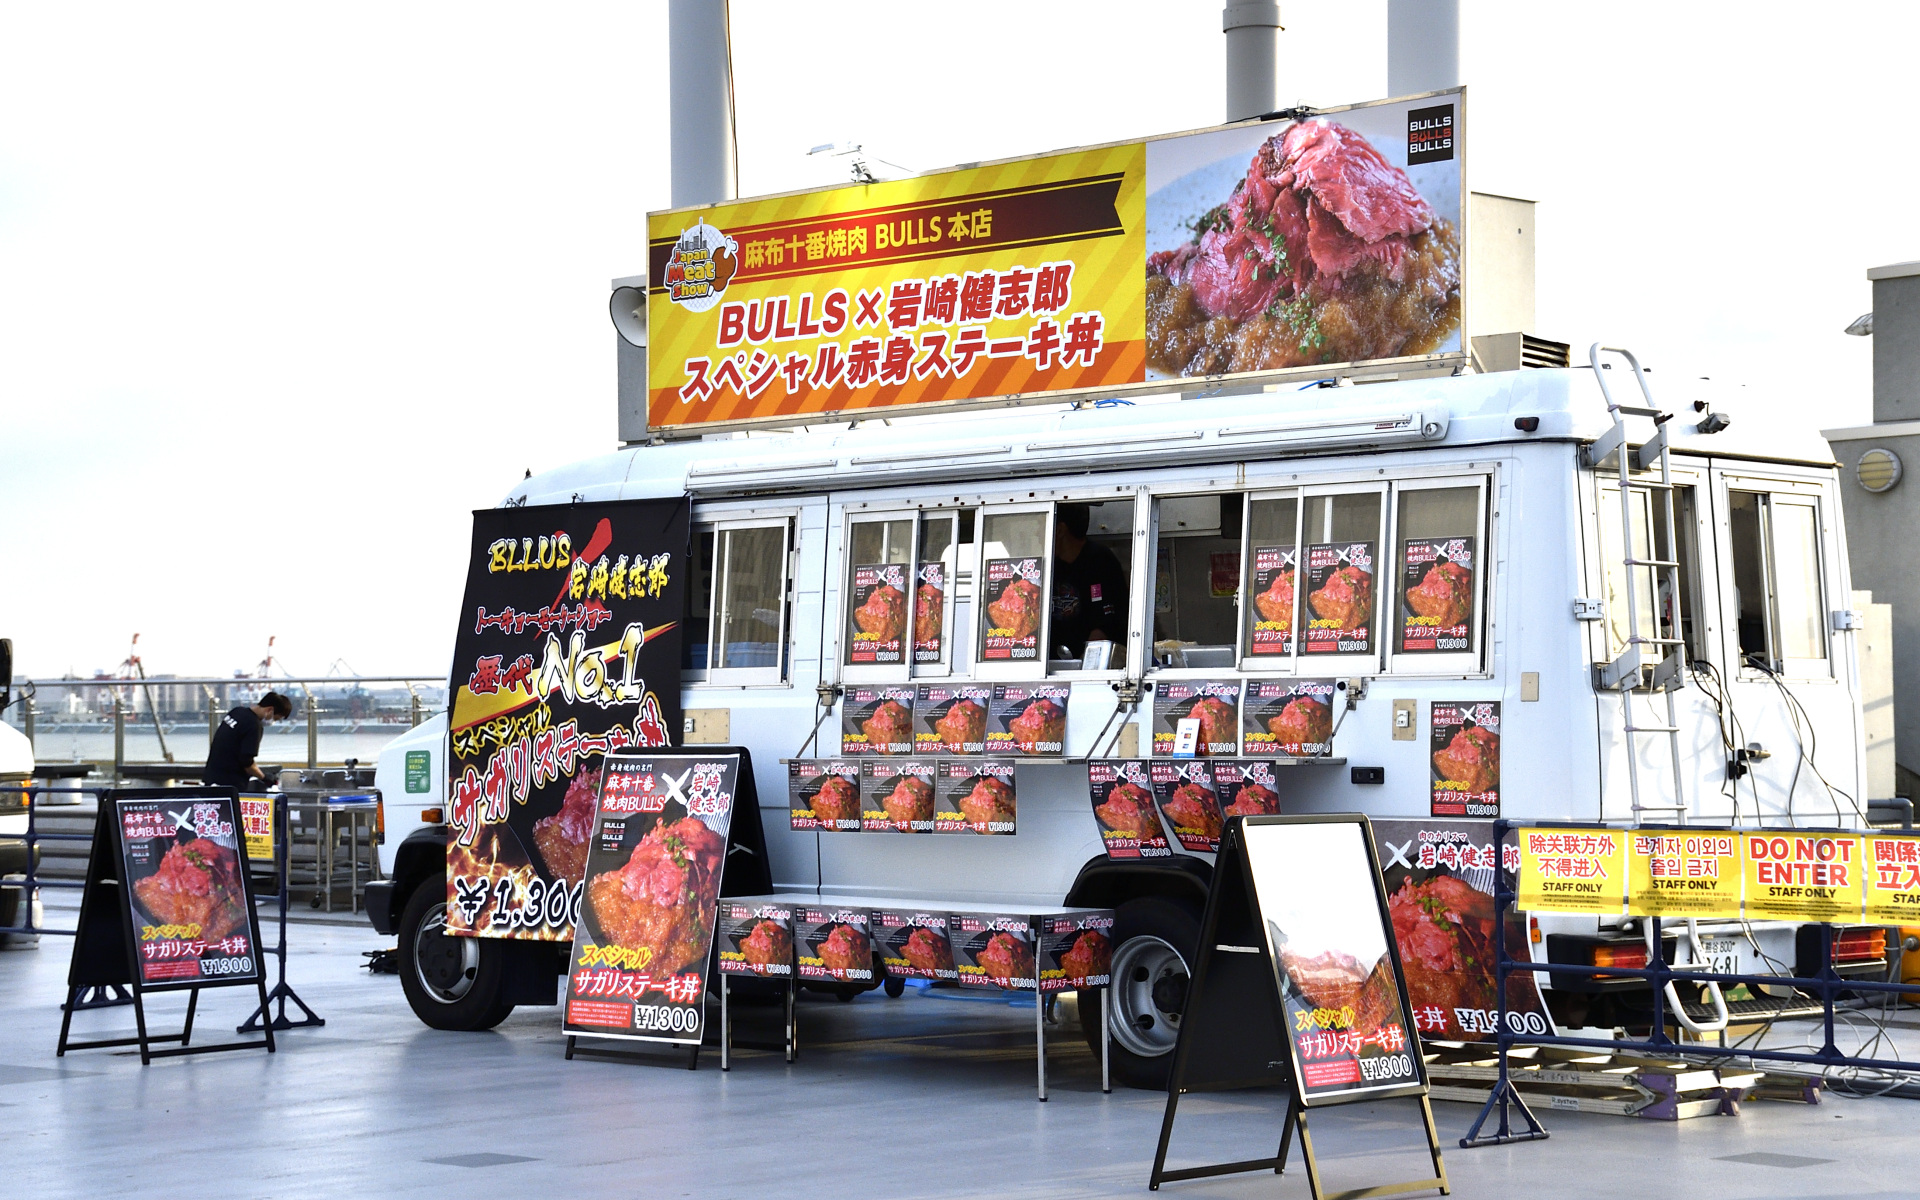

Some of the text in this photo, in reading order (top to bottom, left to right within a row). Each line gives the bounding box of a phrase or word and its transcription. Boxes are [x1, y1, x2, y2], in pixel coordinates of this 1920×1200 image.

[1410, 116, 1451, 131] BULLS
[1410, 128, 1451, 142] BULLS
[1410, 138, 1451, 153] BULLS
[744, 209, 992, 269] 麻布十番焼肉 BULLS 本店
[673, 250, 708, 264] Japan
[667, 261, 715, 283] Meat
[717, 291, 849, 346] BULLS
[887, 261, 1074, 332] 岩崎健志郎
[679, 316, 1103, 403] スペシャル赤身ステーキ丼
[488, 533, 571, 574] BLLUS
[1308, 628, 1368, 640] サガリステーキ丼
[1405, 624, 1468, 637] サガリステーキ丼
[853, 641, 899, 650] サガリステーキ丼
[986, 637, 1036, 647] サガリステーキ丼
[1338, 641, 1368, 651] ¥1300
[1437, 638, 1468, 649] ¥1300
[916, 650, 939, 661] ¥1300
[1011, 648, 1036, 658] ¥1300
[469, 655, 533, 695] 歴代
[453, 702, 552, 760] スペシャル
[843, 743, 886, 752] サガリステーキ丼
[916, 742, 960, 752] サガリステーキ丼
[986, 741, 1033, 752] サガリステーキ丼
[1209, 743, 1236, 752] ¥1300
[1245, 743, 1299, 753] サガリステーキ丼
[605, 773, 656, 792] 麻布十番
[692, 772, 721, 793] 岩崎
[602, 795, 665, 812] 焼肉BULLS
[688, 792, 730, 815] 健志郎
[1433, 791, 1498, 804] サガリステーキ丼
[194, 809, 219, 823] 岩崎
[1466, 804, 1498, 815] ¥1300
[124, 812, 164, 825] 麻布十番
[792, 819, 834, 829] サガリステーキ丼
[863, 820, 908, 830] サガリステーキ丼
[936, 820, 986, 831] サガリステーキ丼
[126, 826, 176, 838] 焼肉BULLS
[1418, 830, 1467, 842] 肉のカリスマ
[1106, 837, 1167, 848] サガリステーキ丼
[1529, 834, 1616, 856] 除关联方外
[1635, 837, 1733, 857] 관계자 이외의
[1750, 837, 1854, 863] DO NOT
[1874, 840, 1920, 863] 関係
[1416, 843, 1521, 872] 岩崎健志郎
[1538, 857, 1608, 878] 不得进入
[1650, 858, 1718, 877] 출입 금지
[1758, 862, 1849, 887] ENTER
[1542, 882, 1603, 893] STAFF ONLY
[1653, 880, 1717, 890] STAFF ONLY
[1769, 887, 1836, 898] STAFF ONLY
[142, 923, 202, 940] スペシャル
[143, 935, 248, 959] サガリステーキ丼
[1720, 941, 1732, 953] 800
[578, 944, 653, 970] スペシャル
[200, 957, 252, 975] ¥1300
[720, 961, 764, 972] サガリステーキ丼
[766, 964, 791, 974] ¥1300
[799, 966, 844, 977] サガリステーキ丼
[1706, 955, 1738, 975] 6-81
[846, 969, 872, 979] ¥1300
[960, 974, 1008, 986] サガリステーキ丼
[574, 969, 702, 1003] サガリステーキ丼
[1040, 977, 1084, 989] サガリステーキ丼
[635, 1005, 699, 1032] ¥1300
[1295, 1005, 1355, 1031] スペシャル
[1298, 1023, 1405, 1059] サガリステーキ丼
[1360, 1054, 1412, 1080] ¥1300
